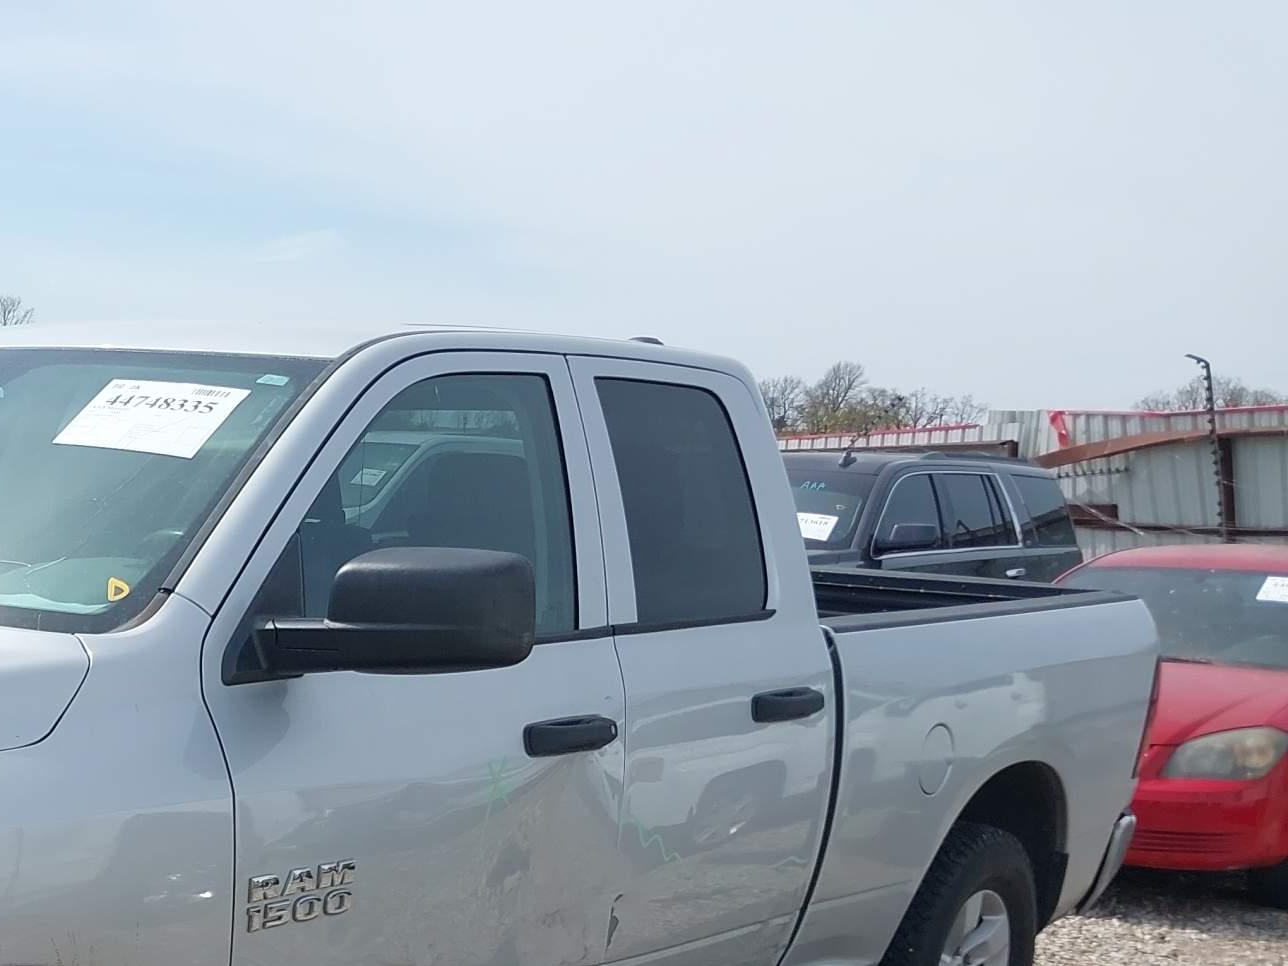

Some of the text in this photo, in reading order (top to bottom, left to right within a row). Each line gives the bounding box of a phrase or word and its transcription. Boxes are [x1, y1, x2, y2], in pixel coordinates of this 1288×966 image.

[105, 394, 219, 414] 44748335
[247, 858, 356, 904] RAM
[246, 887, 353, 933] 1500
